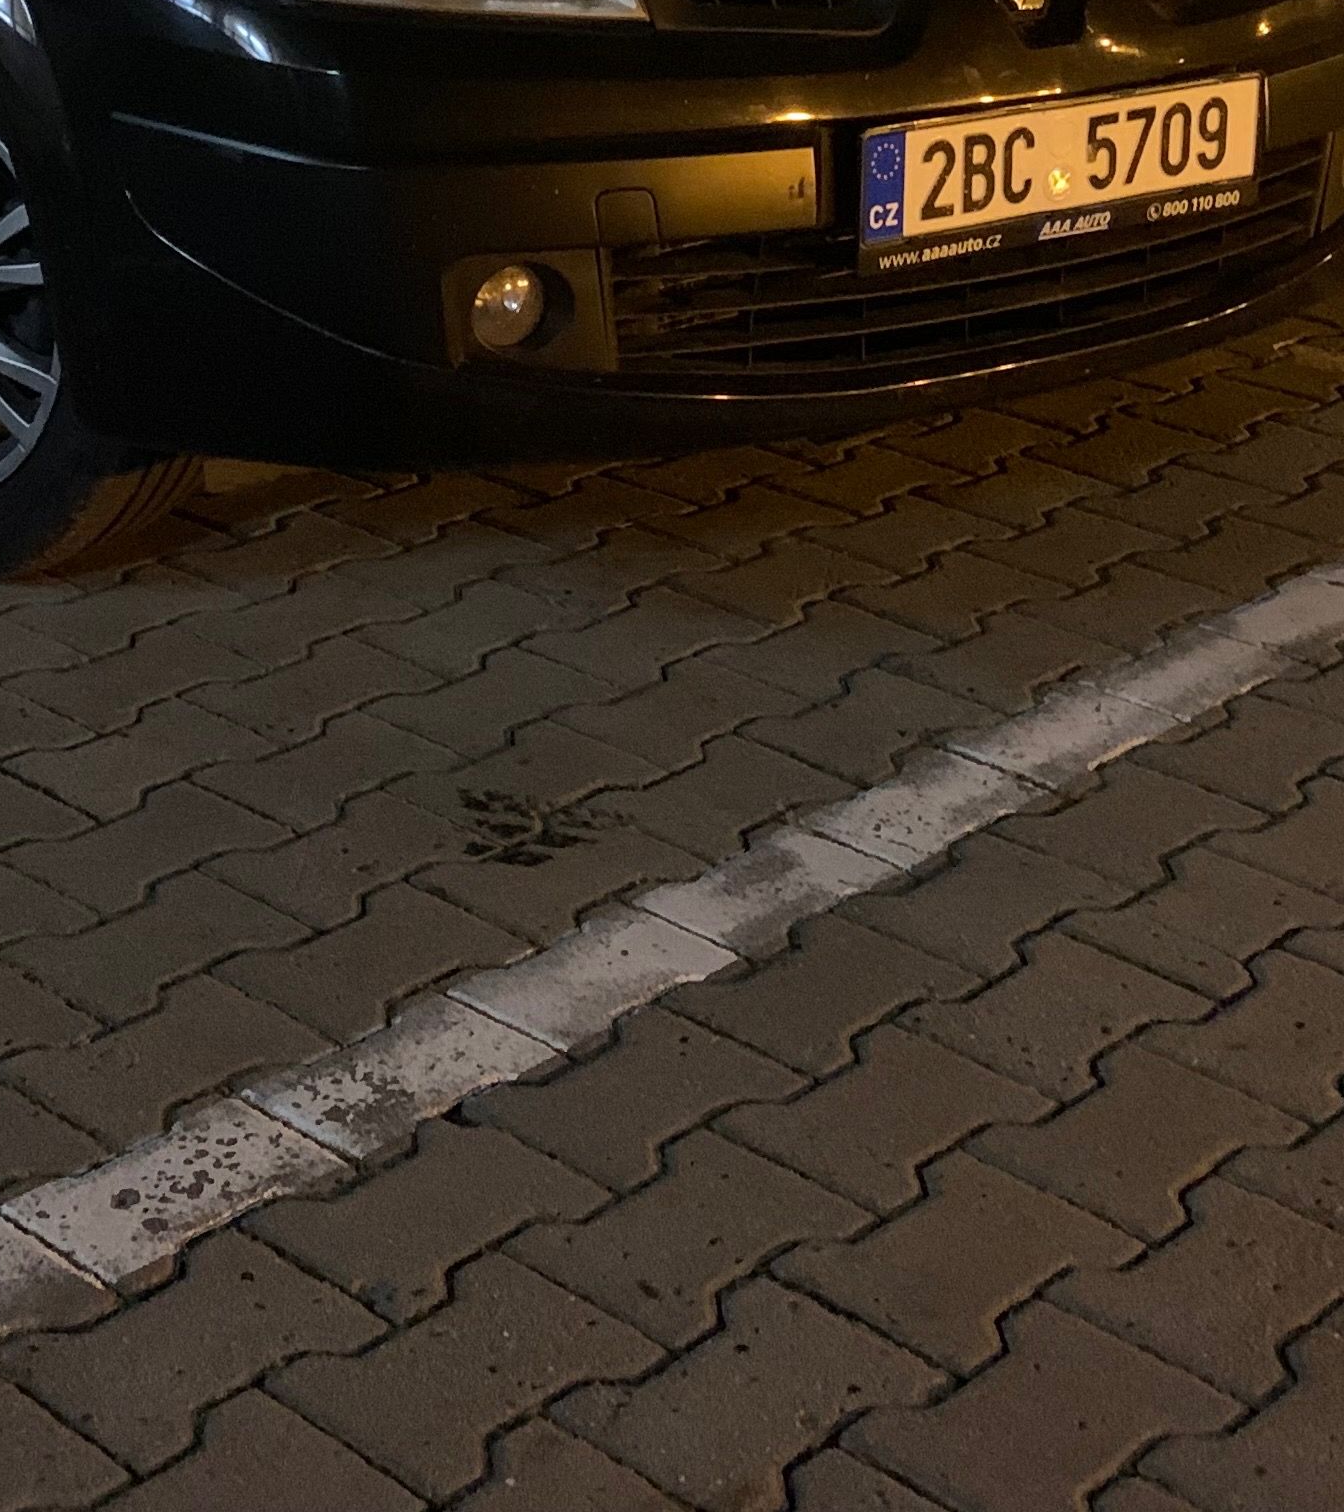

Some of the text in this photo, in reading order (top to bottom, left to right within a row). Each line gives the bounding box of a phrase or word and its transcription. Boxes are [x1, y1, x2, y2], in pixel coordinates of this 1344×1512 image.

[920, 97, 1229, 222] 2BC 5709
[868, 202, 900, 230] CZ
[1163, 190, 1240, 217] 800 110 800
[1039, 211, 1111, 236] AAA AUTO
[878, 233, 1003, 270] www.aaaauto.cz
